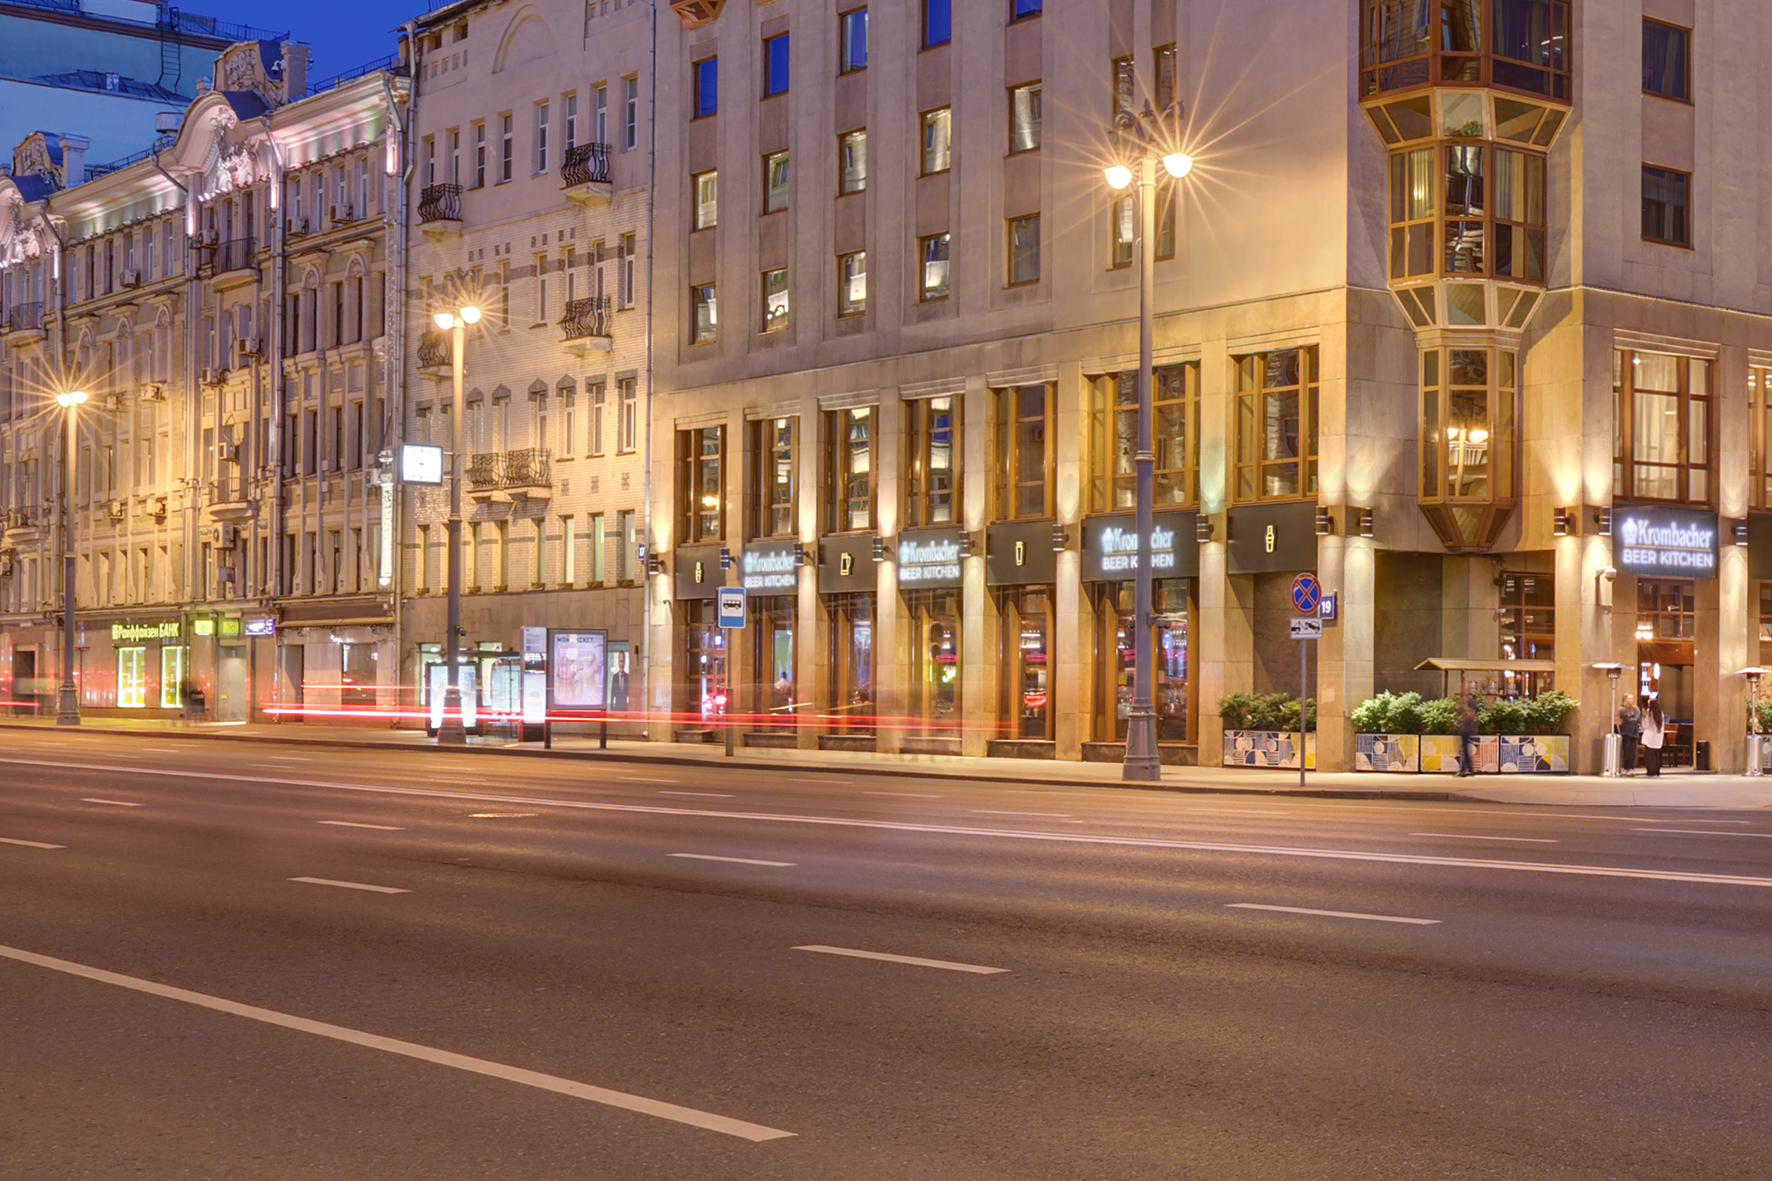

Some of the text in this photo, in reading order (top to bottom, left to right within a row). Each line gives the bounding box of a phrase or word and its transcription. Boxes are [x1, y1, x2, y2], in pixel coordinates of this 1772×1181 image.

[1113, 524, 1174, 551] Kromcher
[1638, 519, 1713, 549] Krombacher
[909, 539, 959, 563] Krombacher
[1623, 549, 1713, 567] BEER KITCHEN
[1102, 553, 1174, 570] BEER KHEN
[900, 564, 960, 580] BEER KITCHEN
[744, 574, 795, 588] BEER KITCHEN
[1321, 600, 1332, 614] 19
[159, 622, 180, 638] БАНК
